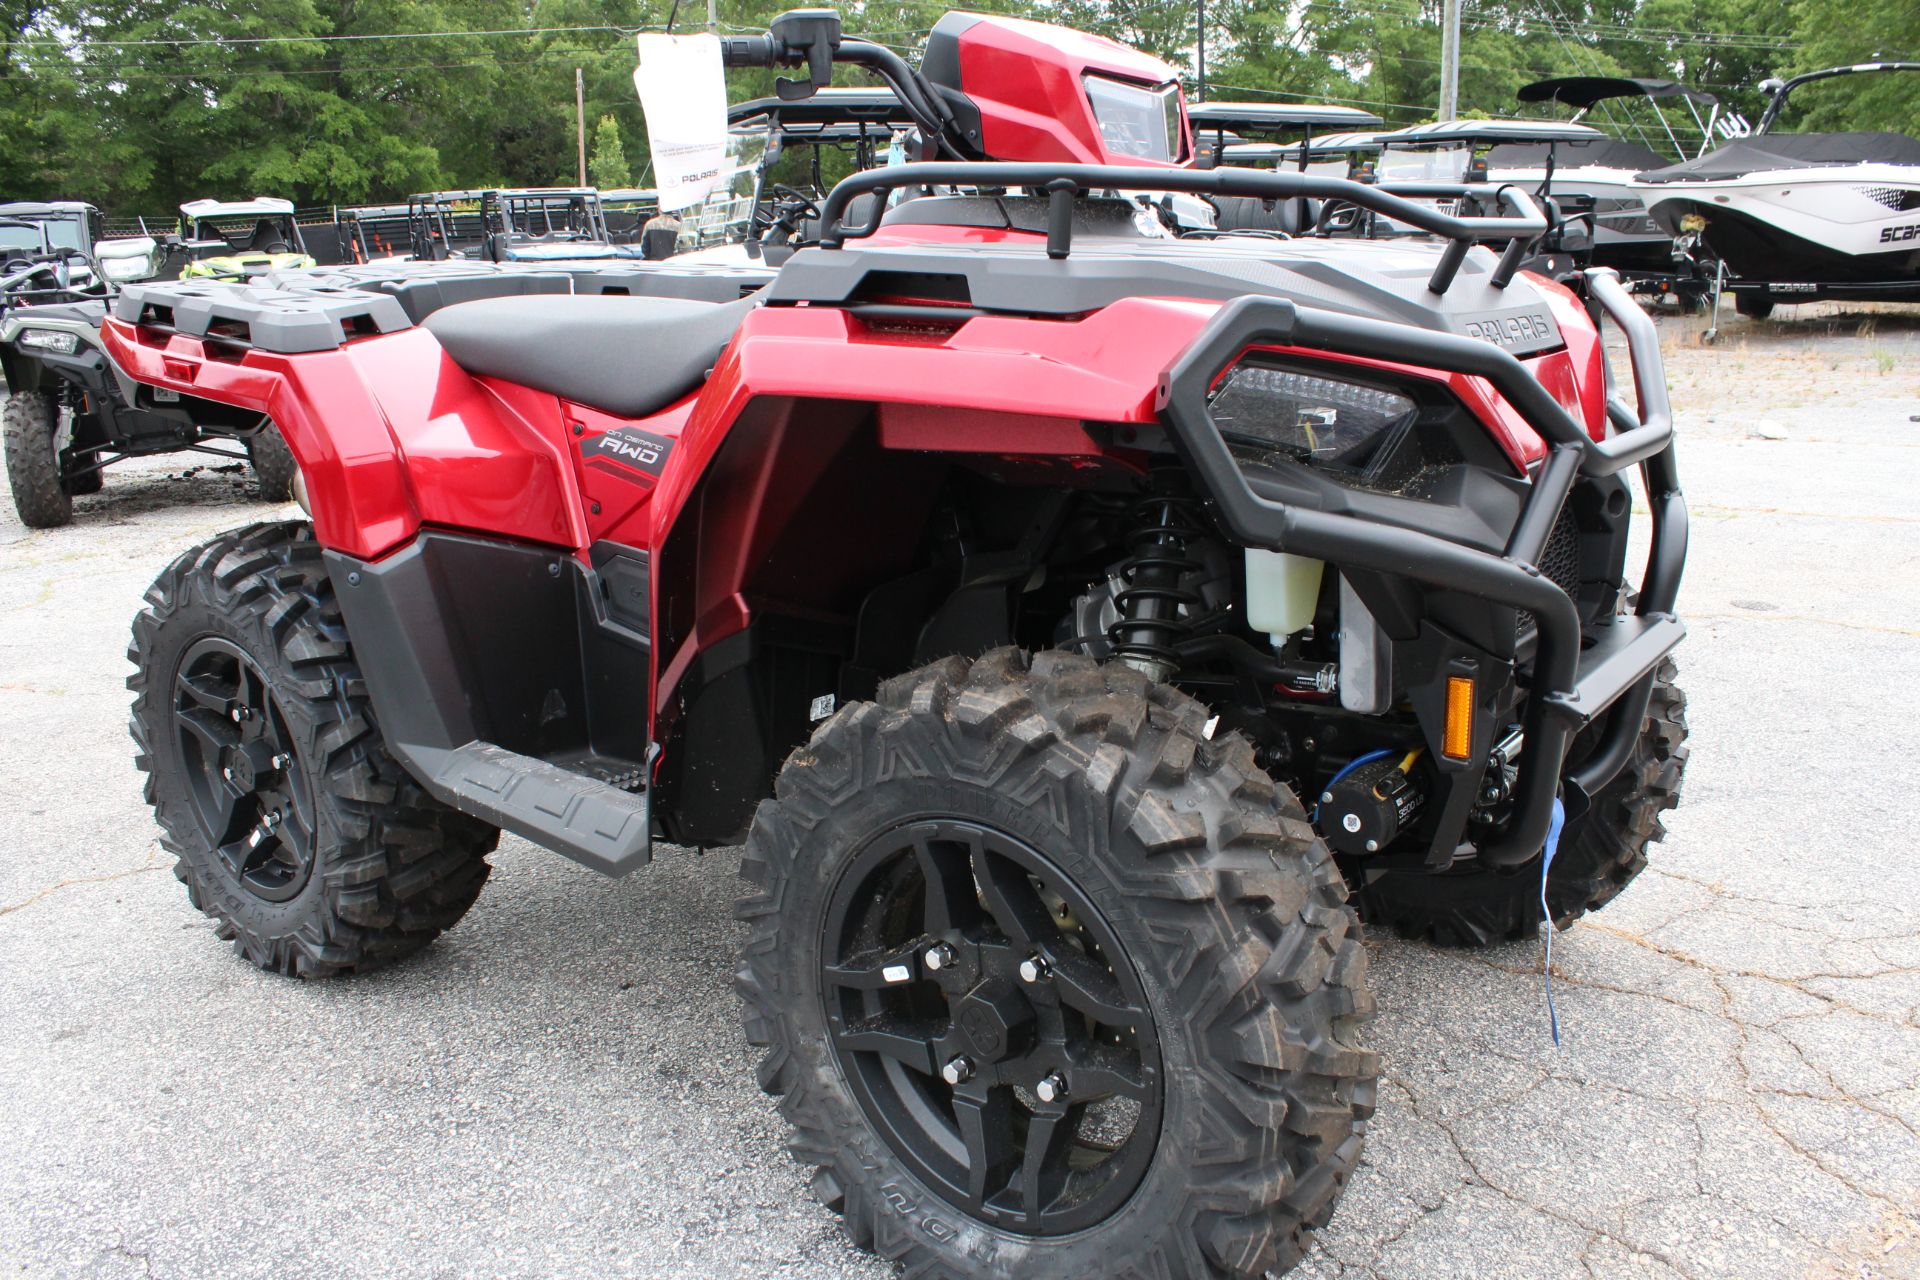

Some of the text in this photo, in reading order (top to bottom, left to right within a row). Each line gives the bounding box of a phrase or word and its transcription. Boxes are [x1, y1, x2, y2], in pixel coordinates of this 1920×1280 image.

[682, 168, 719, 184] POLARIS
[1466, 314, 1551, 346] POLARIS
[598, 436, 659, 464] AWD
[606, 429, 664, 452] ON DEMAND
